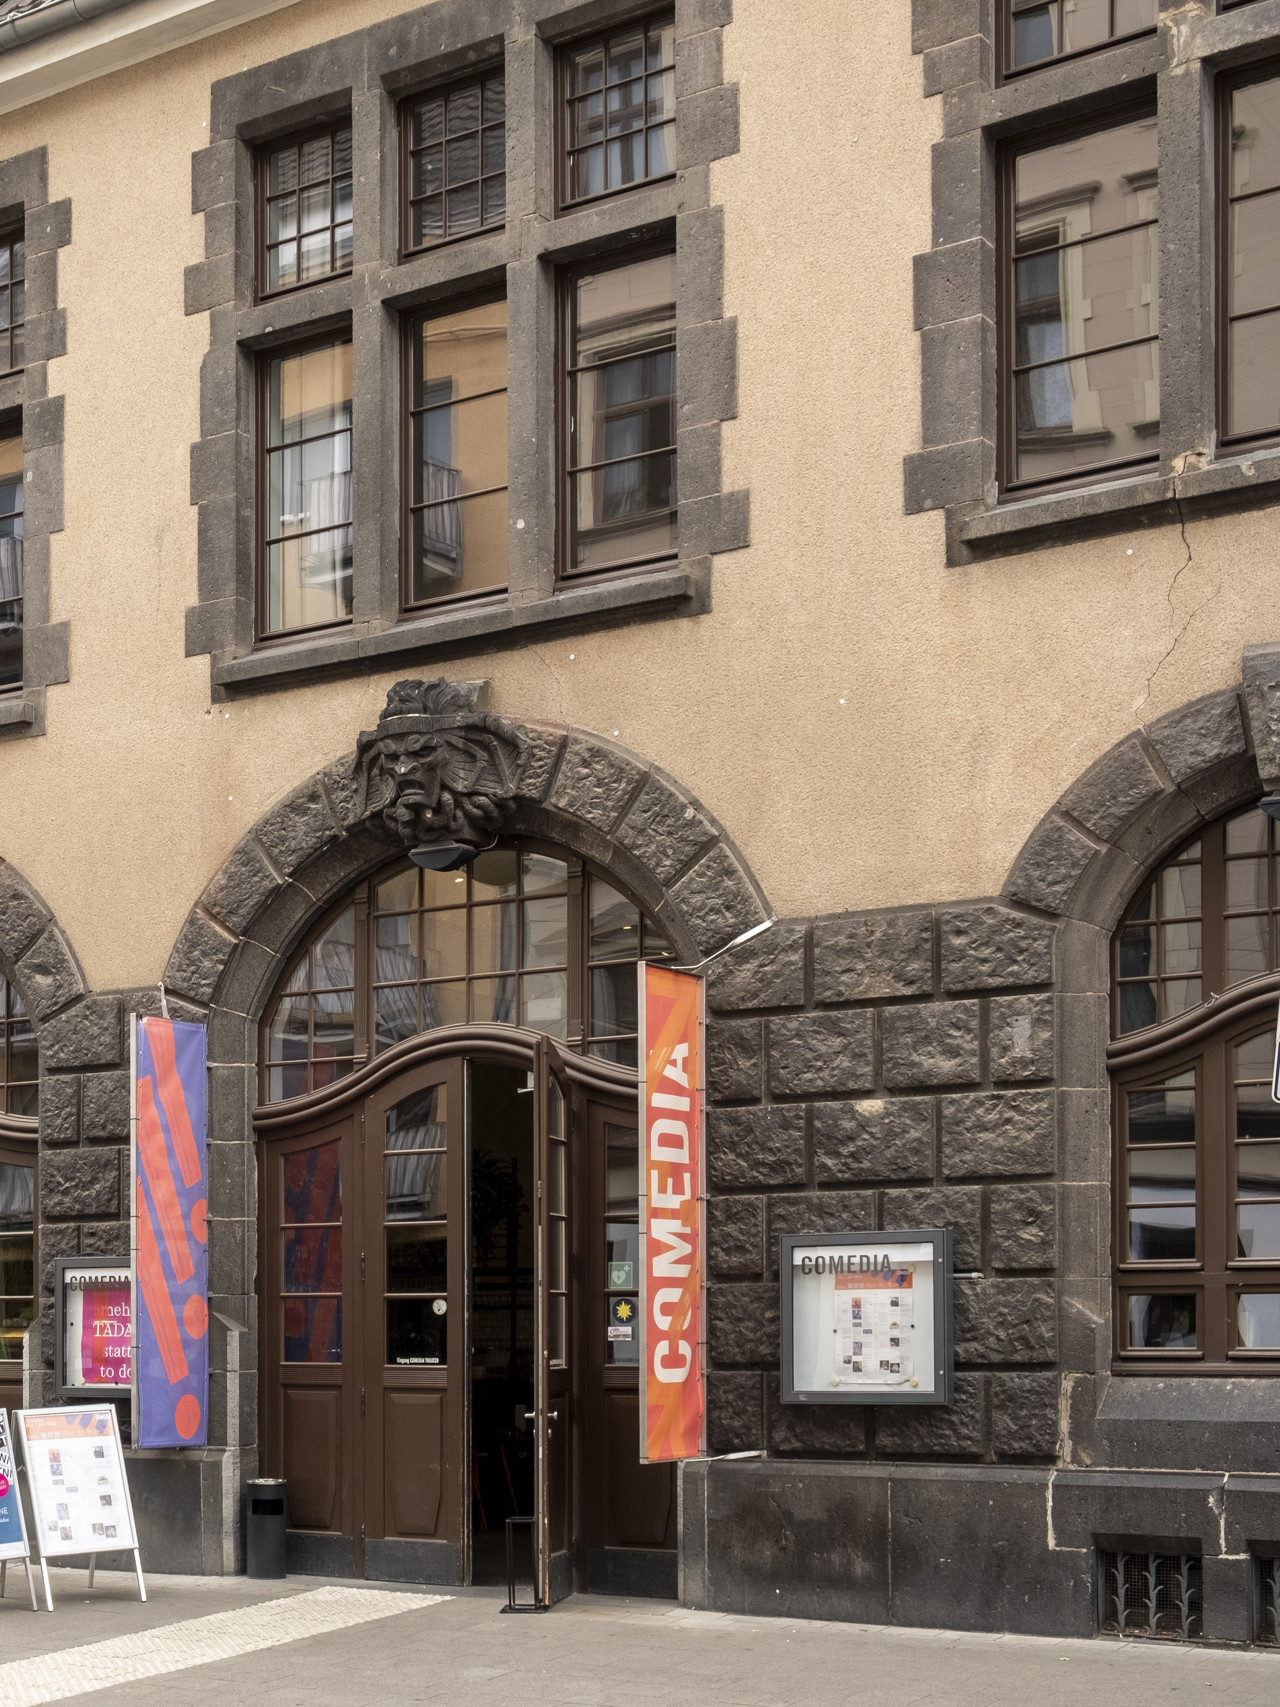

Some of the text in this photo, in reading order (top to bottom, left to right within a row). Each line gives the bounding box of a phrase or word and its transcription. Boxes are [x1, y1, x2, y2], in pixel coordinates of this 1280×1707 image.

[650, 1042, 692, 1384] COMEDIA
[801, 1254, 892, 1276] COMEDIA
[100, 1365, 115, 1378] to
